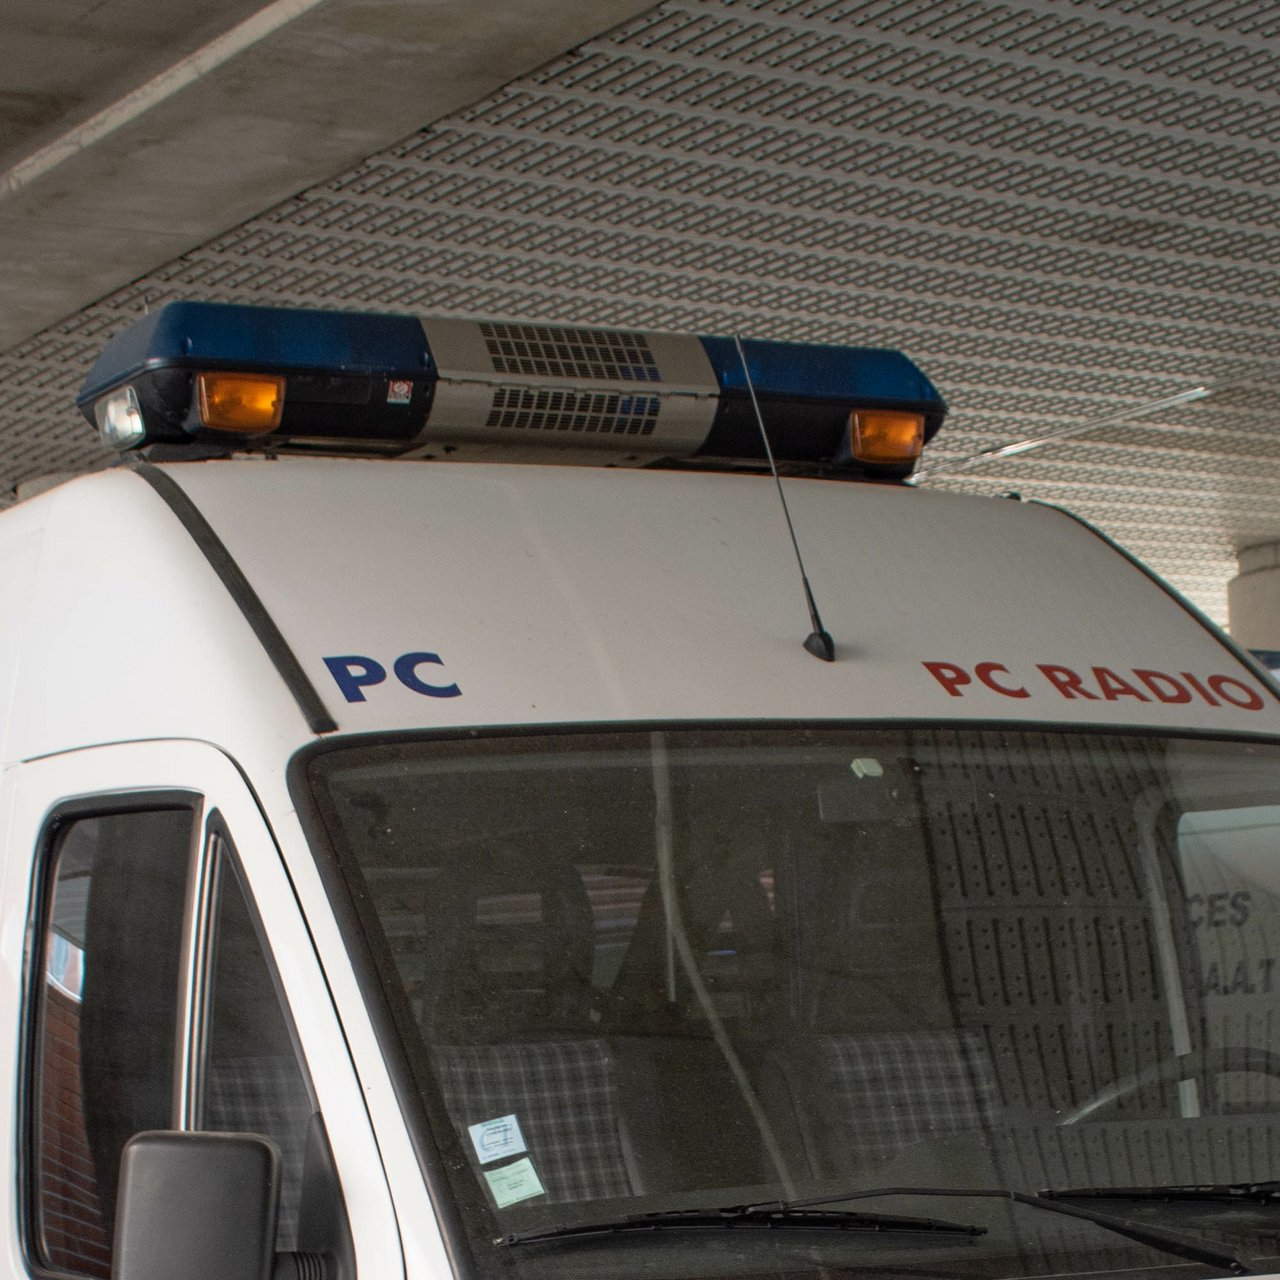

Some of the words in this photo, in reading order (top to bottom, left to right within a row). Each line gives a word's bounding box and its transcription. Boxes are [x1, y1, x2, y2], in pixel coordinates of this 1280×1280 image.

[323, 651, 462, 703] PC
[923, 661, 1030, 700] PC
[1035, 663, 1266, 713] RADIO
